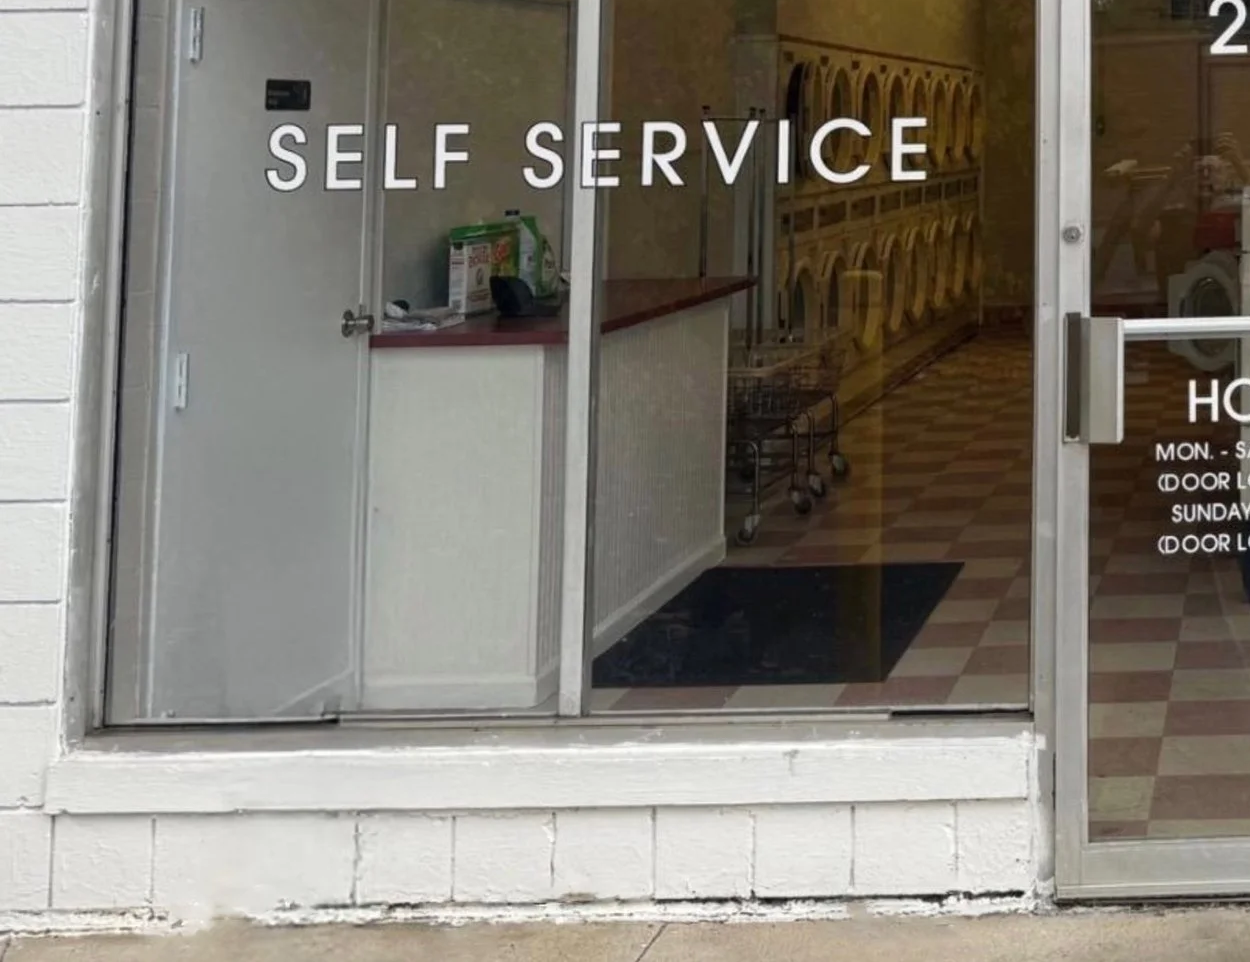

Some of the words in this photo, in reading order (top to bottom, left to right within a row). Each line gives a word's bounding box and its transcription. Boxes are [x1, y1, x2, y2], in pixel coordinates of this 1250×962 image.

[264, 122, 471, 192] SELF
[522, 116, 929, 189] SERVICE
[1157, 472, 1230, 493] (DOOR
[1157, 535, 1230, 554] (DOOR
